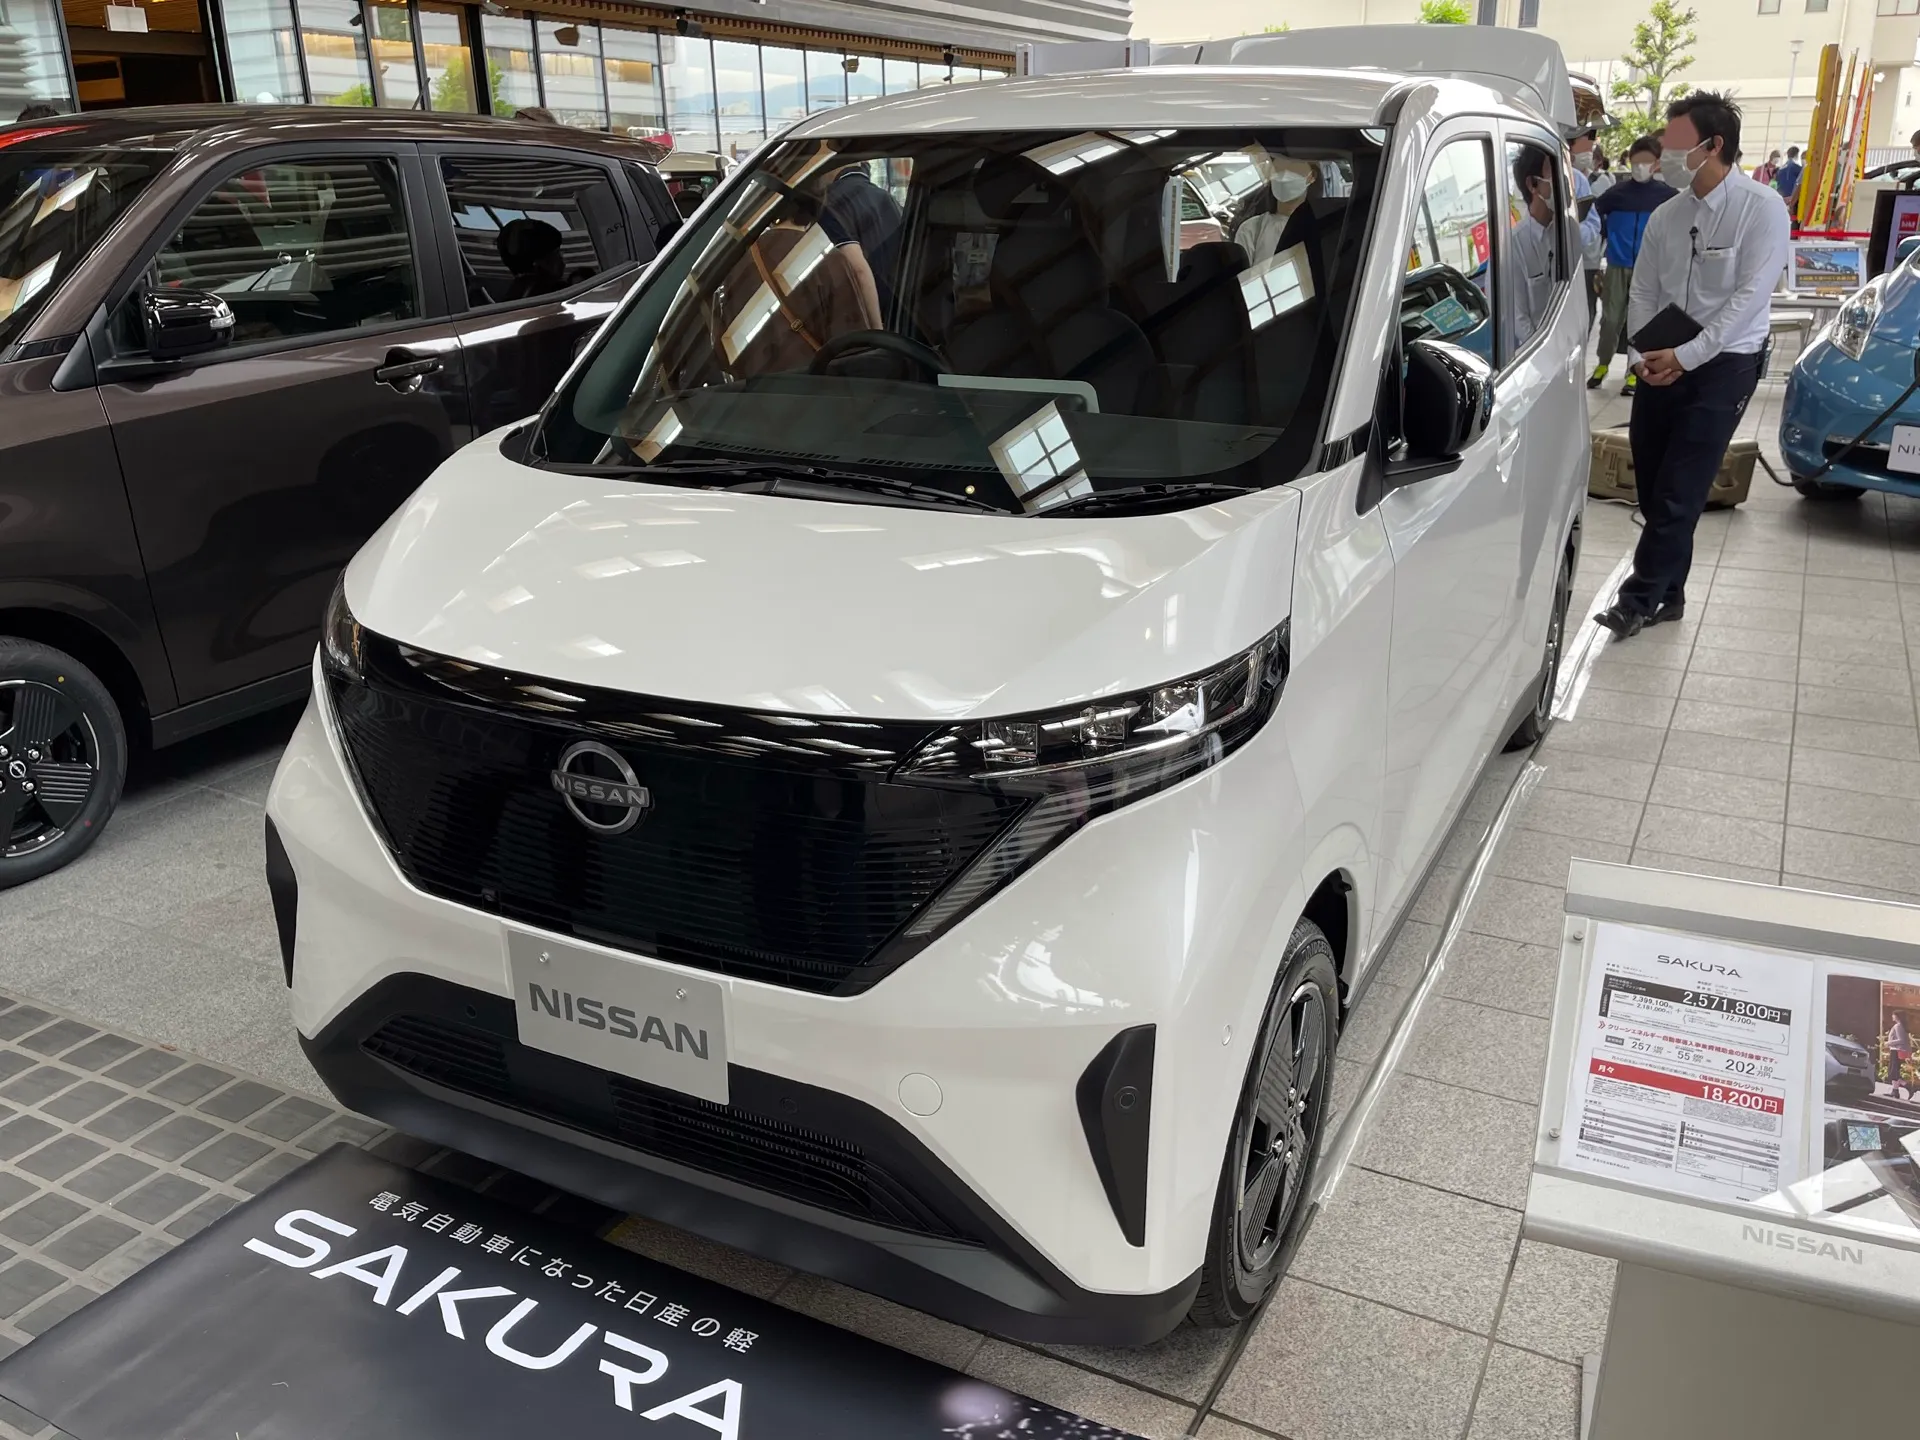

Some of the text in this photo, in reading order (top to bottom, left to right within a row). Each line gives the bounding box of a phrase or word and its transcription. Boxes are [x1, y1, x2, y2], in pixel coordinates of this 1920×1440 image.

[1897, 443, 1920, 456] NI
[553, 773, 646, 806] NISSAN
[1656, 954, 1743, 979] SAKURA
[528, 982, 709, 1061] NISSAN
[1682, 991, 1782, 1022] 2,571,800円
[1725, 1058, 1756, 1076] 202
[1701, 1085, 1779, 1113] 18,200円
[1742, 1224, 1863, 1265] NISSAN
[368, 1189, 760, 1355] 電気自動車になった日産の軽
[243, 1208, 744, 1440] SAKURA
